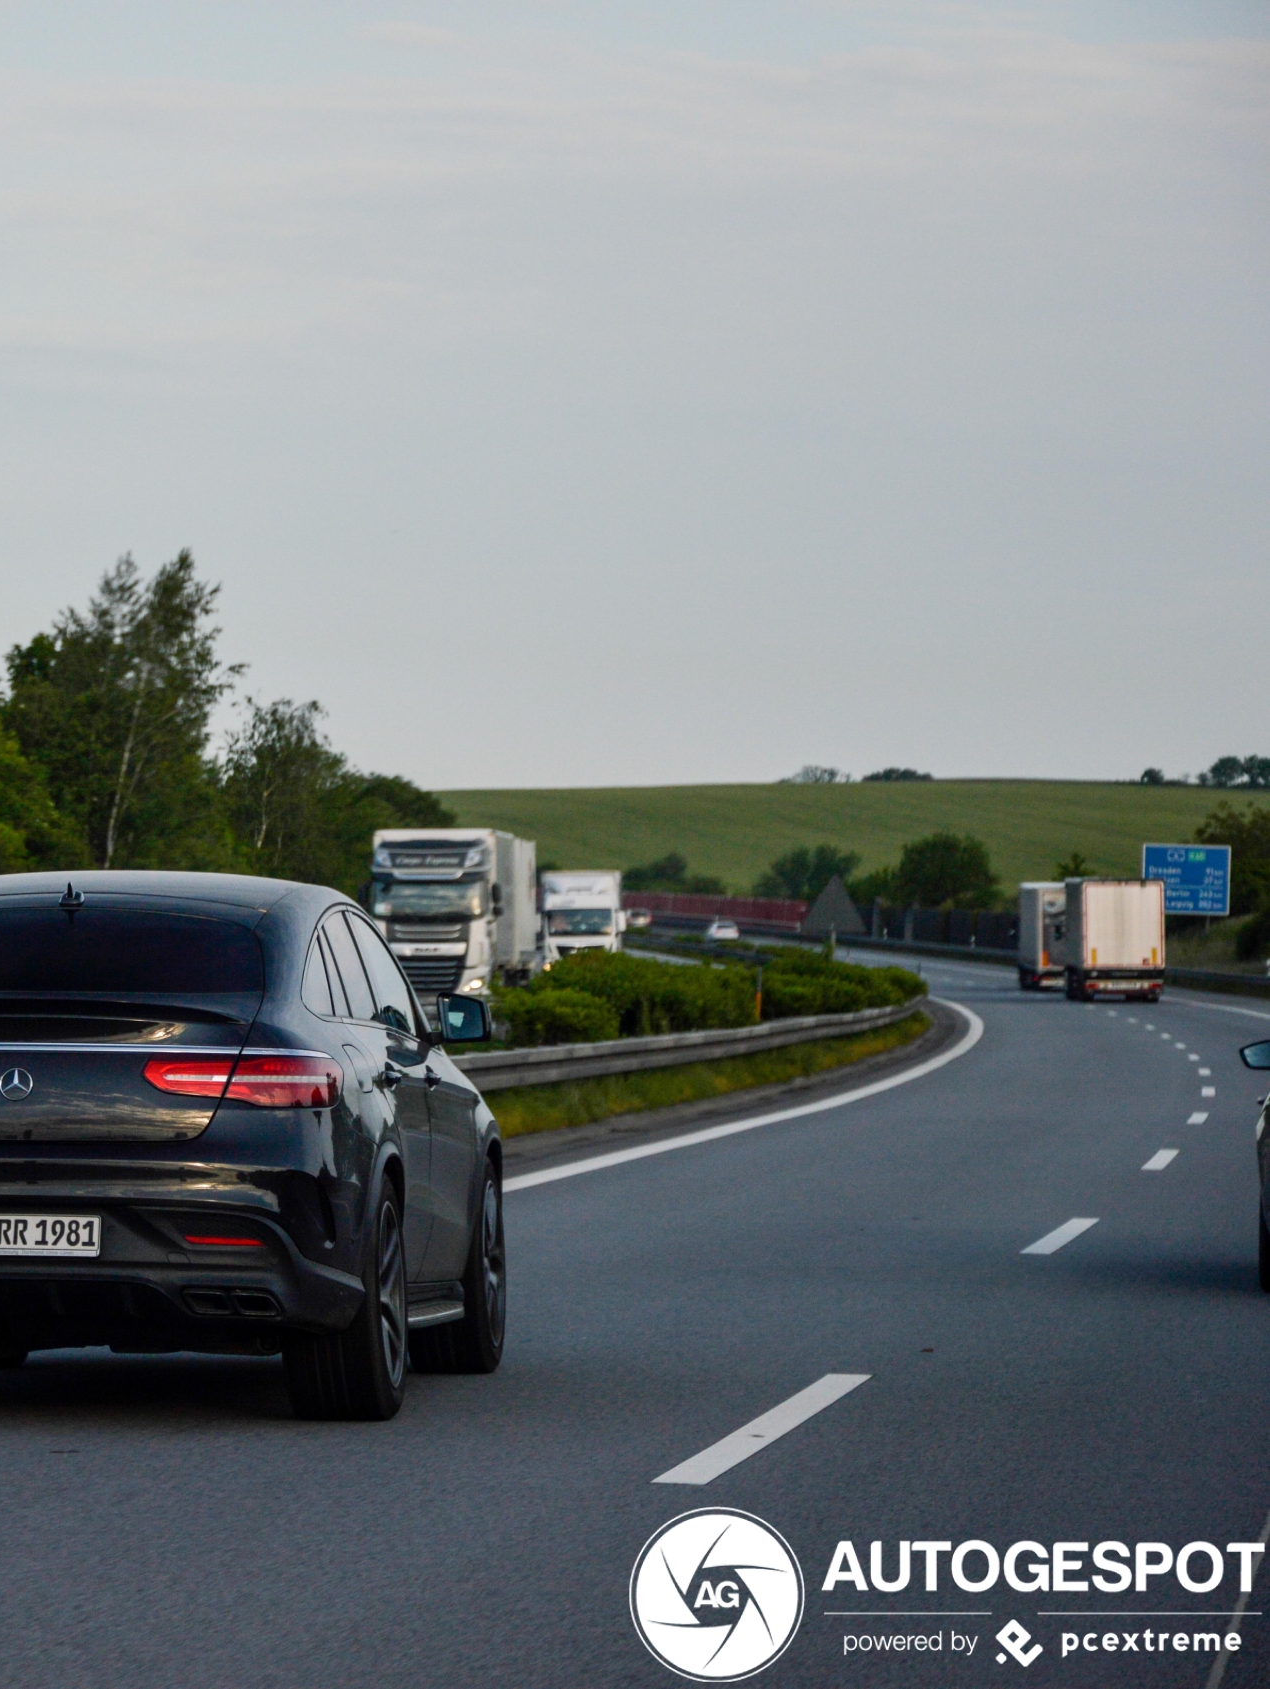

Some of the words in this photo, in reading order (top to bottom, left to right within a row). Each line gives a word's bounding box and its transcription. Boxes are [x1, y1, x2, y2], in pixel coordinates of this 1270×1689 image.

[1149, 866, 1182, 875] Dresden
[1166, 900, 1194, 910] Leipzig
[34, 1219, 96, 1247] 1981
